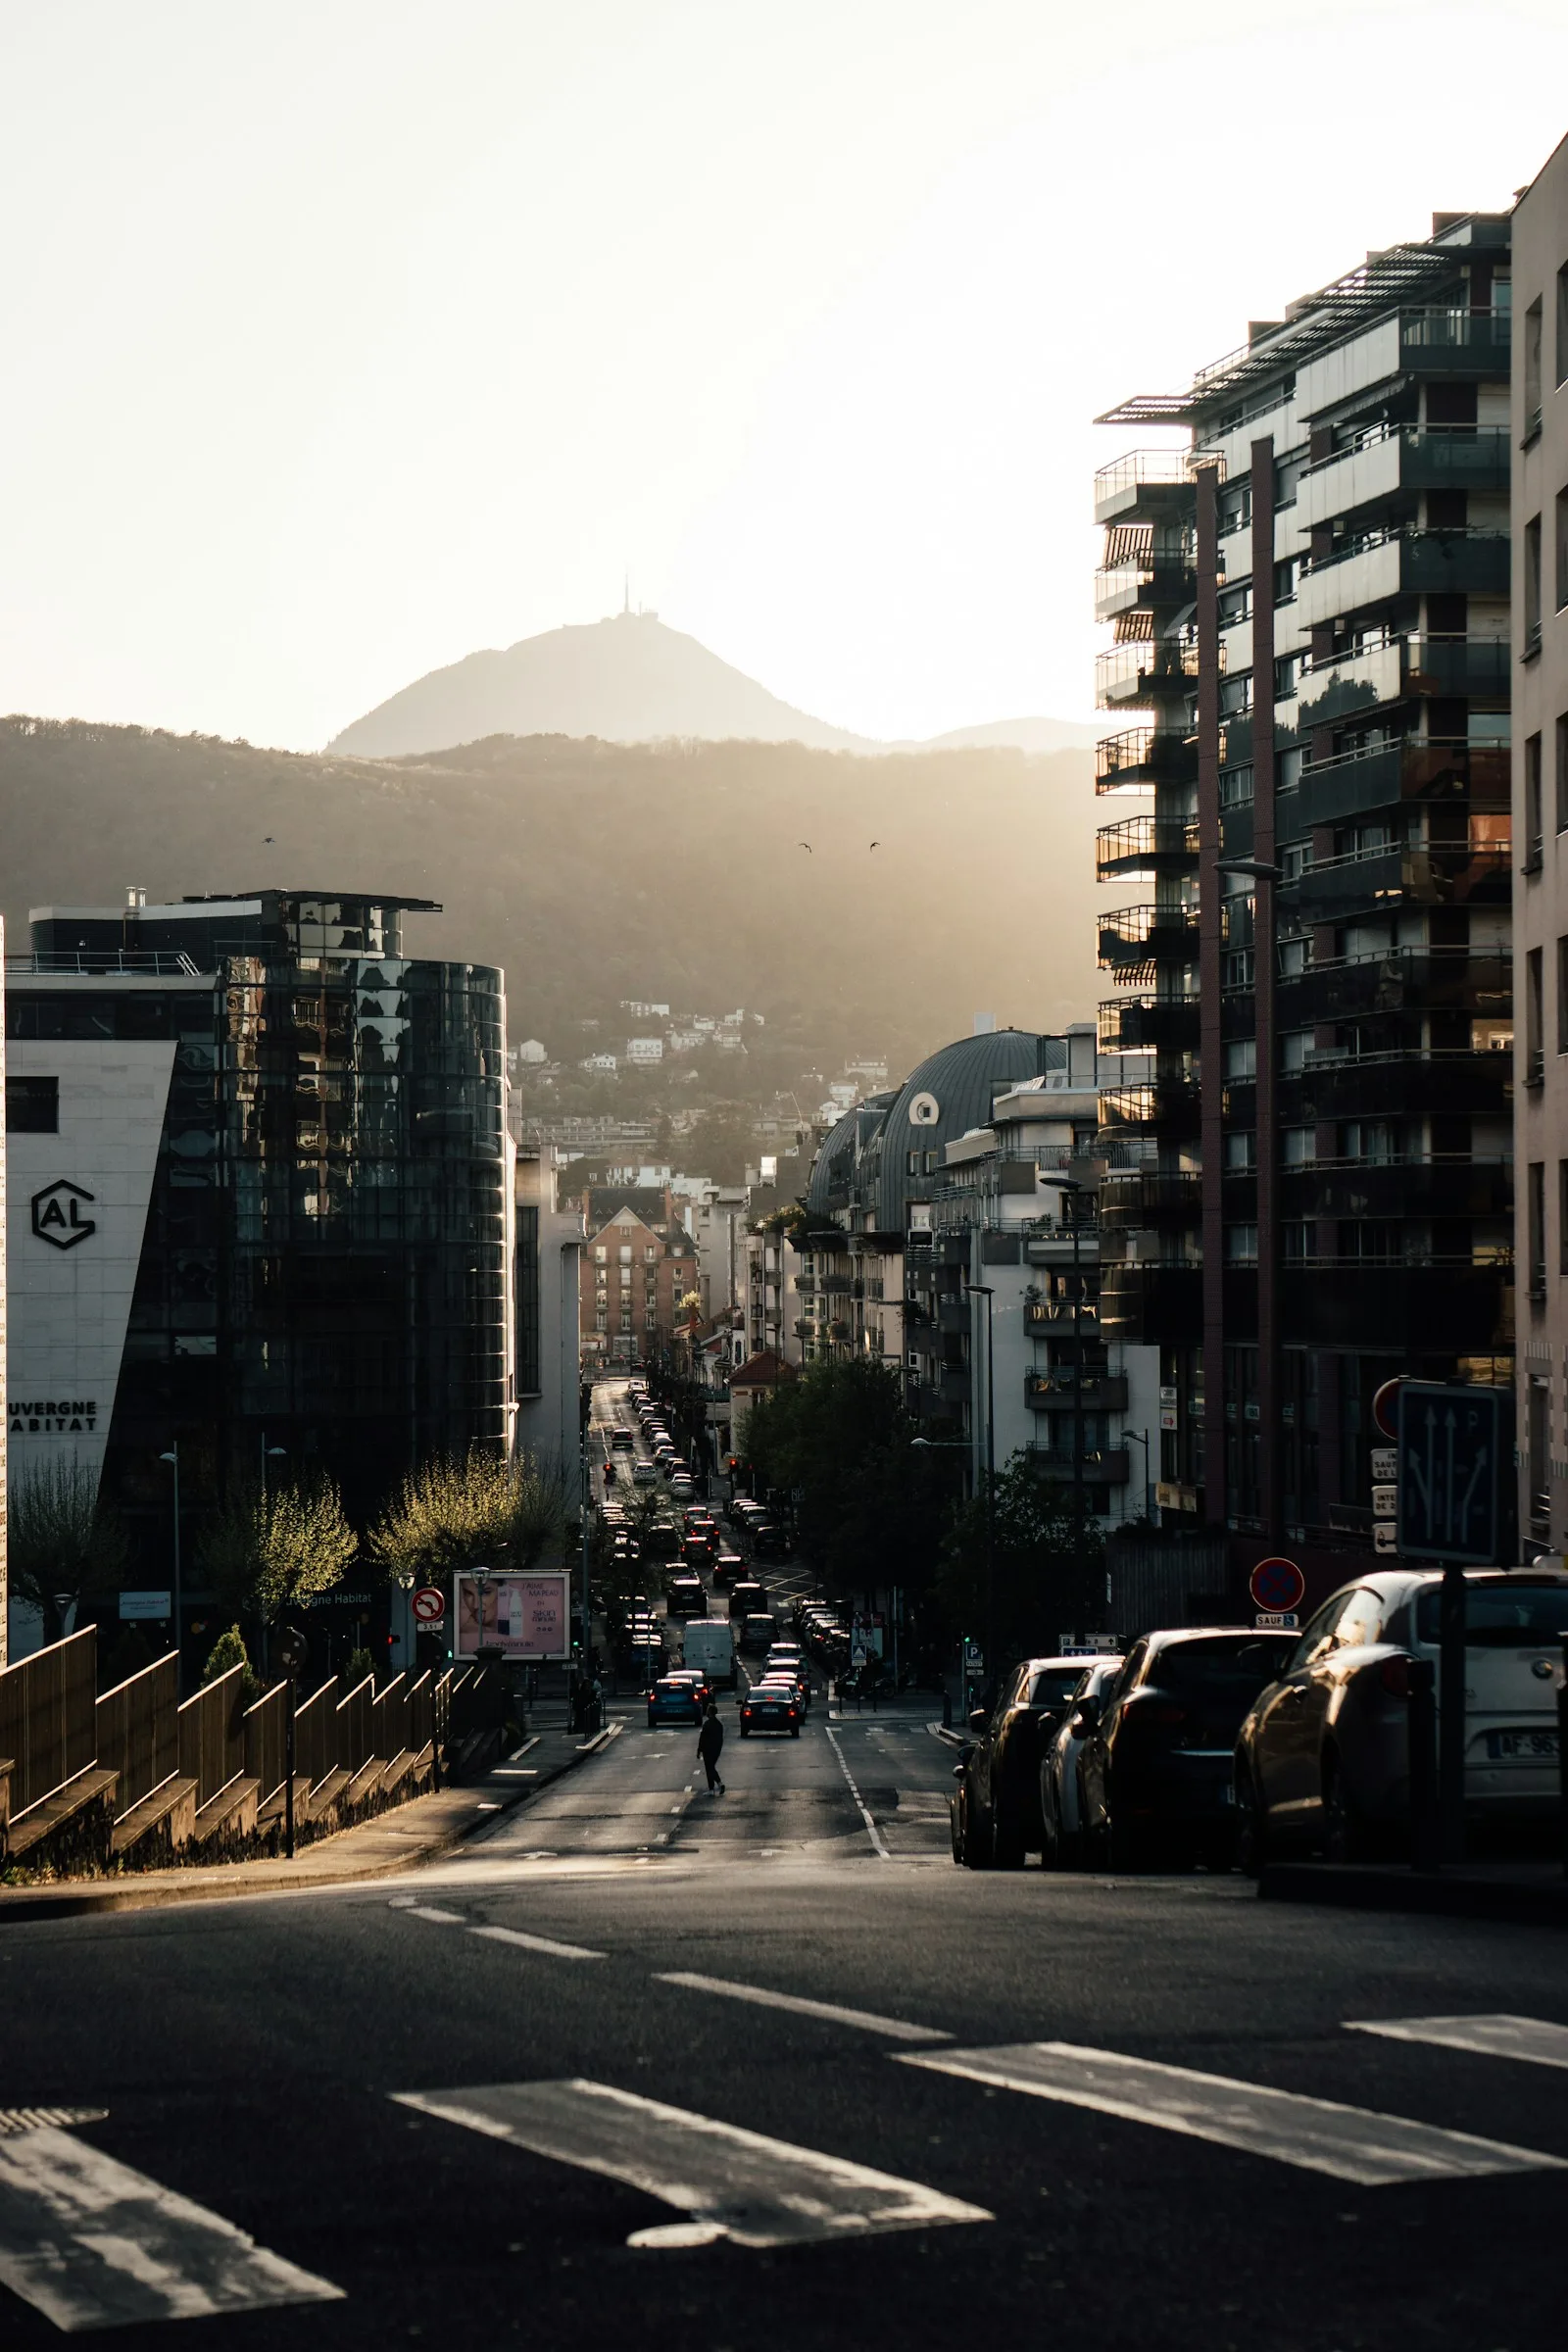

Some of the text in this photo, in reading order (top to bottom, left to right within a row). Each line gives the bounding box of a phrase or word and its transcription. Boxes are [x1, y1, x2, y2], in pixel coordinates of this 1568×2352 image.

[10, 1418, 96, 1432] ABITAT
[1467, 1409, 1479, 1434] P
[334, 1592, 372, 1604] Habitat
[1257, 1616, 1282, 1625] SAUF
[970, 1646, 978, 1658] P
